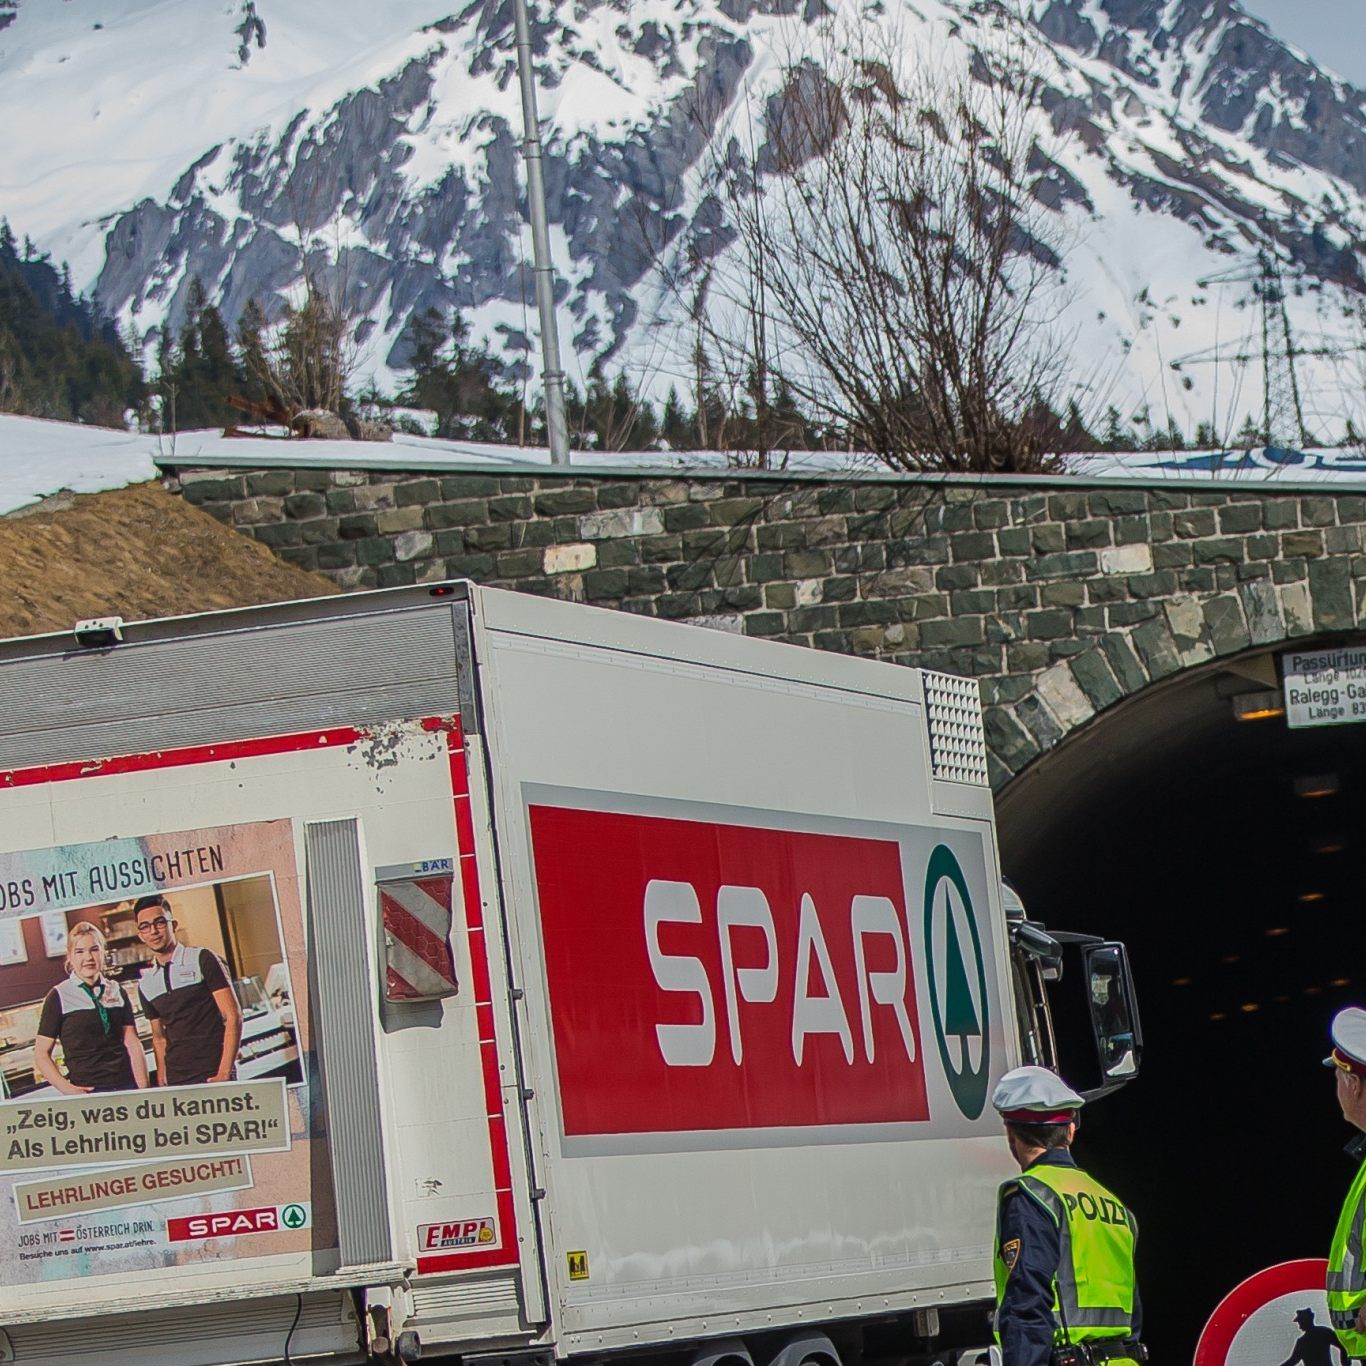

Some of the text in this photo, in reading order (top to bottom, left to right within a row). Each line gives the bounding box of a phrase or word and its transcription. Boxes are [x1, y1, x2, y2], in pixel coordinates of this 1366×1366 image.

[42, 871, 78, 902] MIT
[89, 845, 224, 894] AUSSICHTEN
[643, 879, 916, 1067] SPAR
[82, 1105, 129, 1124] was
[136, 1099, 165, 1120] du
[173, 1092, 261, 1117] kannst.
[7, 1139, 44, 1160] Als
[52, 1132, 147, 1156] Lehrling
[154, 1125, 189, 1148] bei
[27, 1158, 243, 1210] LEHRLINGE GESUCHT!
[18, 1234, 41, 1248] JOBS
[43, 1231, 59, 1244] MIT
[76, 1223, 130, 1240] ÖSTERREICH
[189, 1212, 277, 1236] SPAR
[19, 1249, 53, 1261] Besuche
[54, 1248, 70, 1258] uns
[70, 1246, 83, 1257] auf
